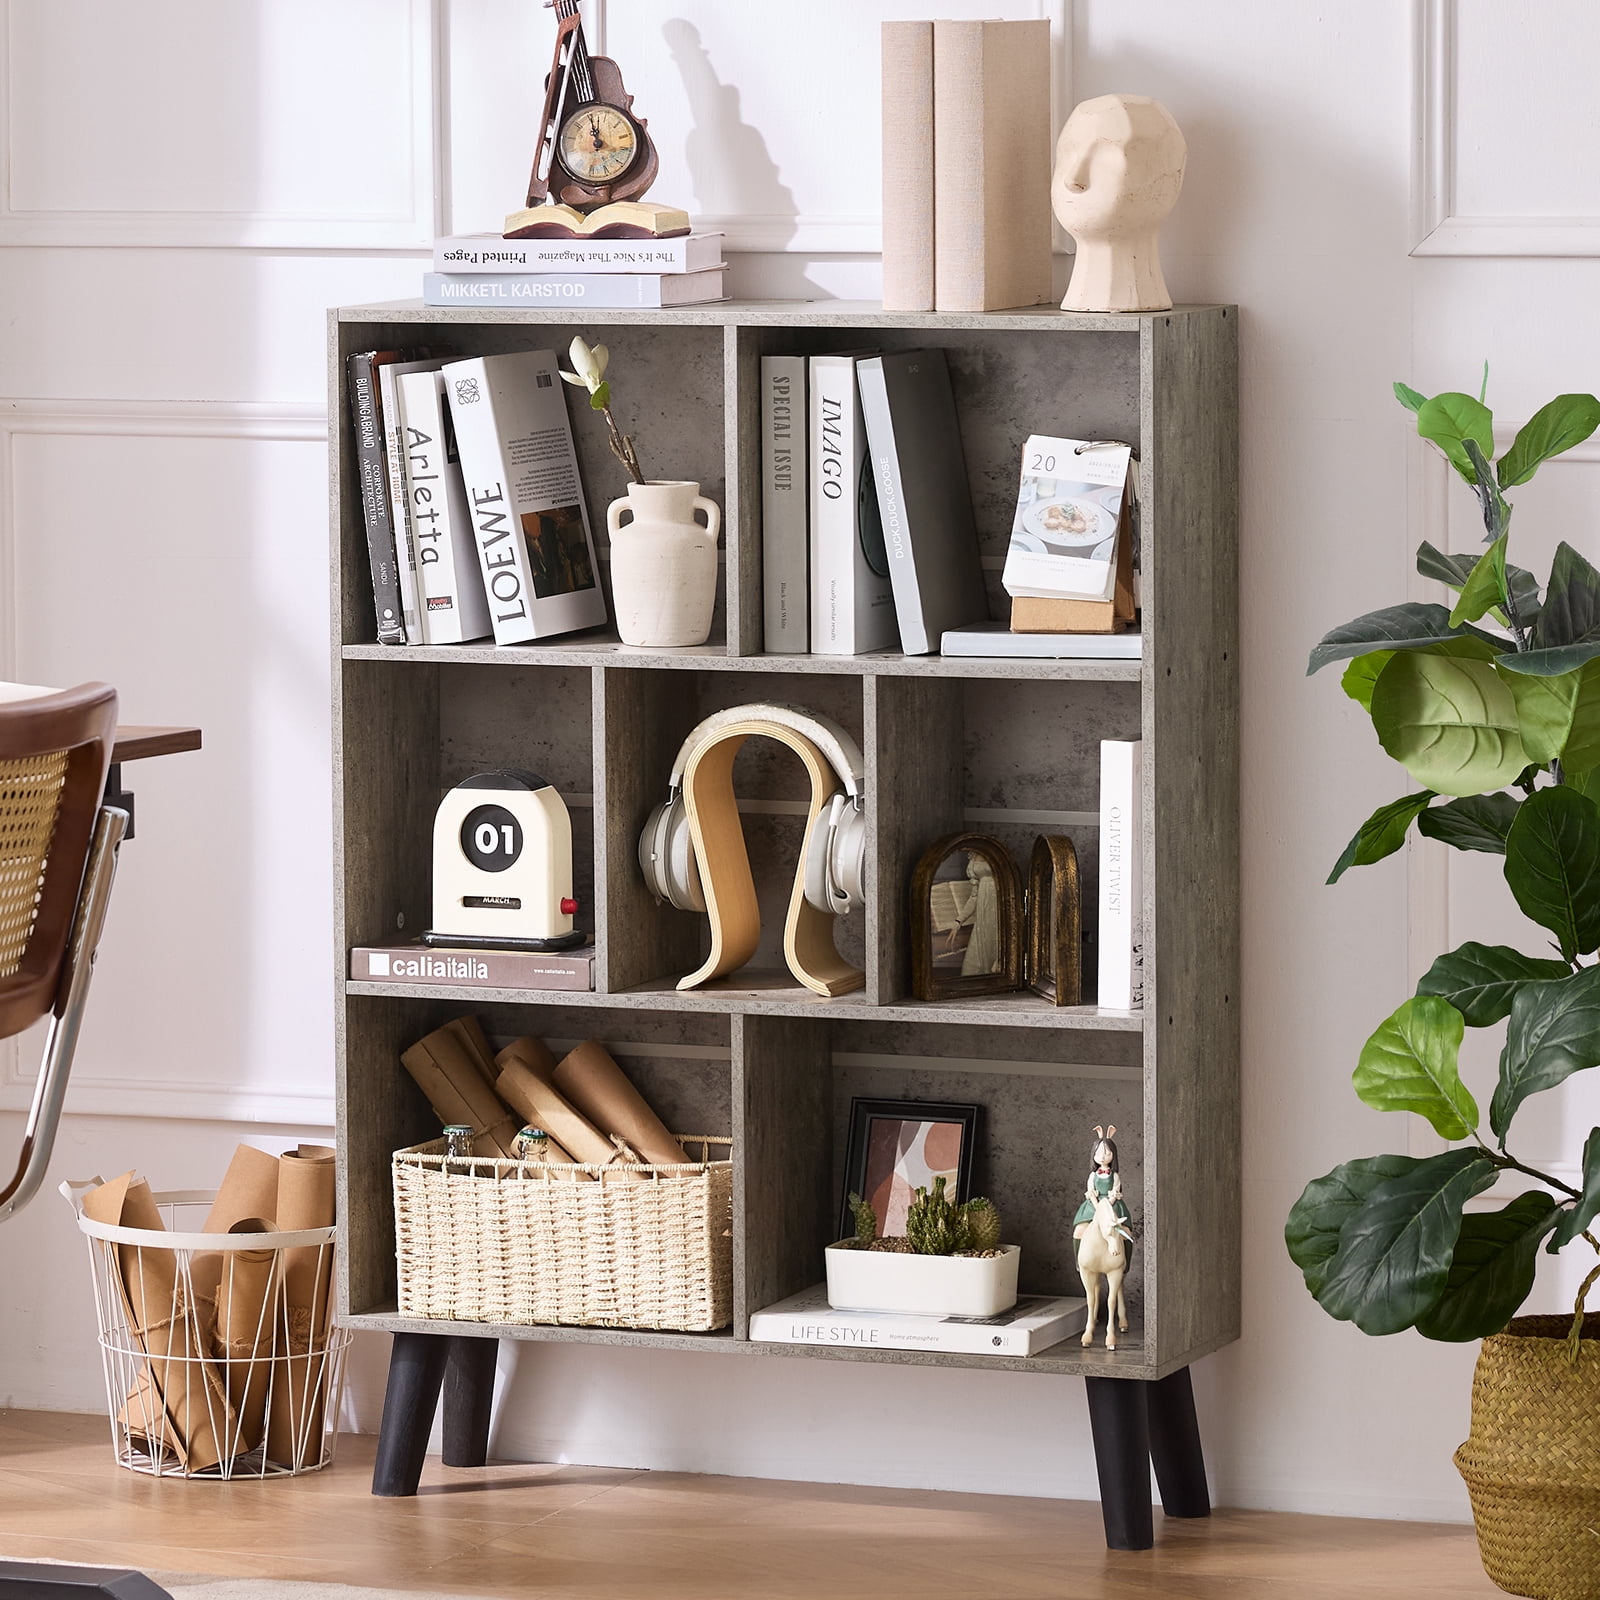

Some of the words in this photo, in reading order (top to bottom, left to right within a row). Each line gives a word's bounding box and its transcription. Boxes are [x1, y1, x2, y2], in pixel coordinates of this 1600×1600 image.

[443, 249, 478, 264] Pages
[482, 251, 527, 264] Printed
[538, 250, 585, 263] Magazine
[588, 252, 611, 262] That
[613, 252, 636, 262] Nice
[656, 252, 675, 262] The
[440, 283, 507, 298] MIKKETL
[511, 283, 585, 298] KARSTOD
[356, 377, 371, 415] BUILDING
[772, 376, 791, 441] SPECIAL
[360, 420, 375, 448] BRAND
[387, 431, 397, 461] STYLE
[822, 395, 842, 499] IMAGO
[390, 462, 399, 474] AT
[774, 448, 792, 491] ISSUE
[1031, 453, 1056, 472] 20
[363, 458, 378, 527] ARCHITECTURE
[372, 464, 385, 518] CORPORATE
[391, 476, 401, 505] HOME
[406, 427, 442, 566] Arletta
[472, 482, 526, 623] LOEWE
[380, 562, 388, 585] SANDU
[829, 580, 837, 601] Visually
[474, 822, 514, 855] 01
[1109, 806, 1122, 863] OLIVER
[482, 896, 510, 904] MARCH
[1109, 867, 1121, 914] TWIST
[392, 956, 489, 979] caliaitalia
[790, 1325, 825, 1341] LIFE
[829, 1327, 879, 1343] STYLE
[906, 1334, 940, 1343] atmosphere
